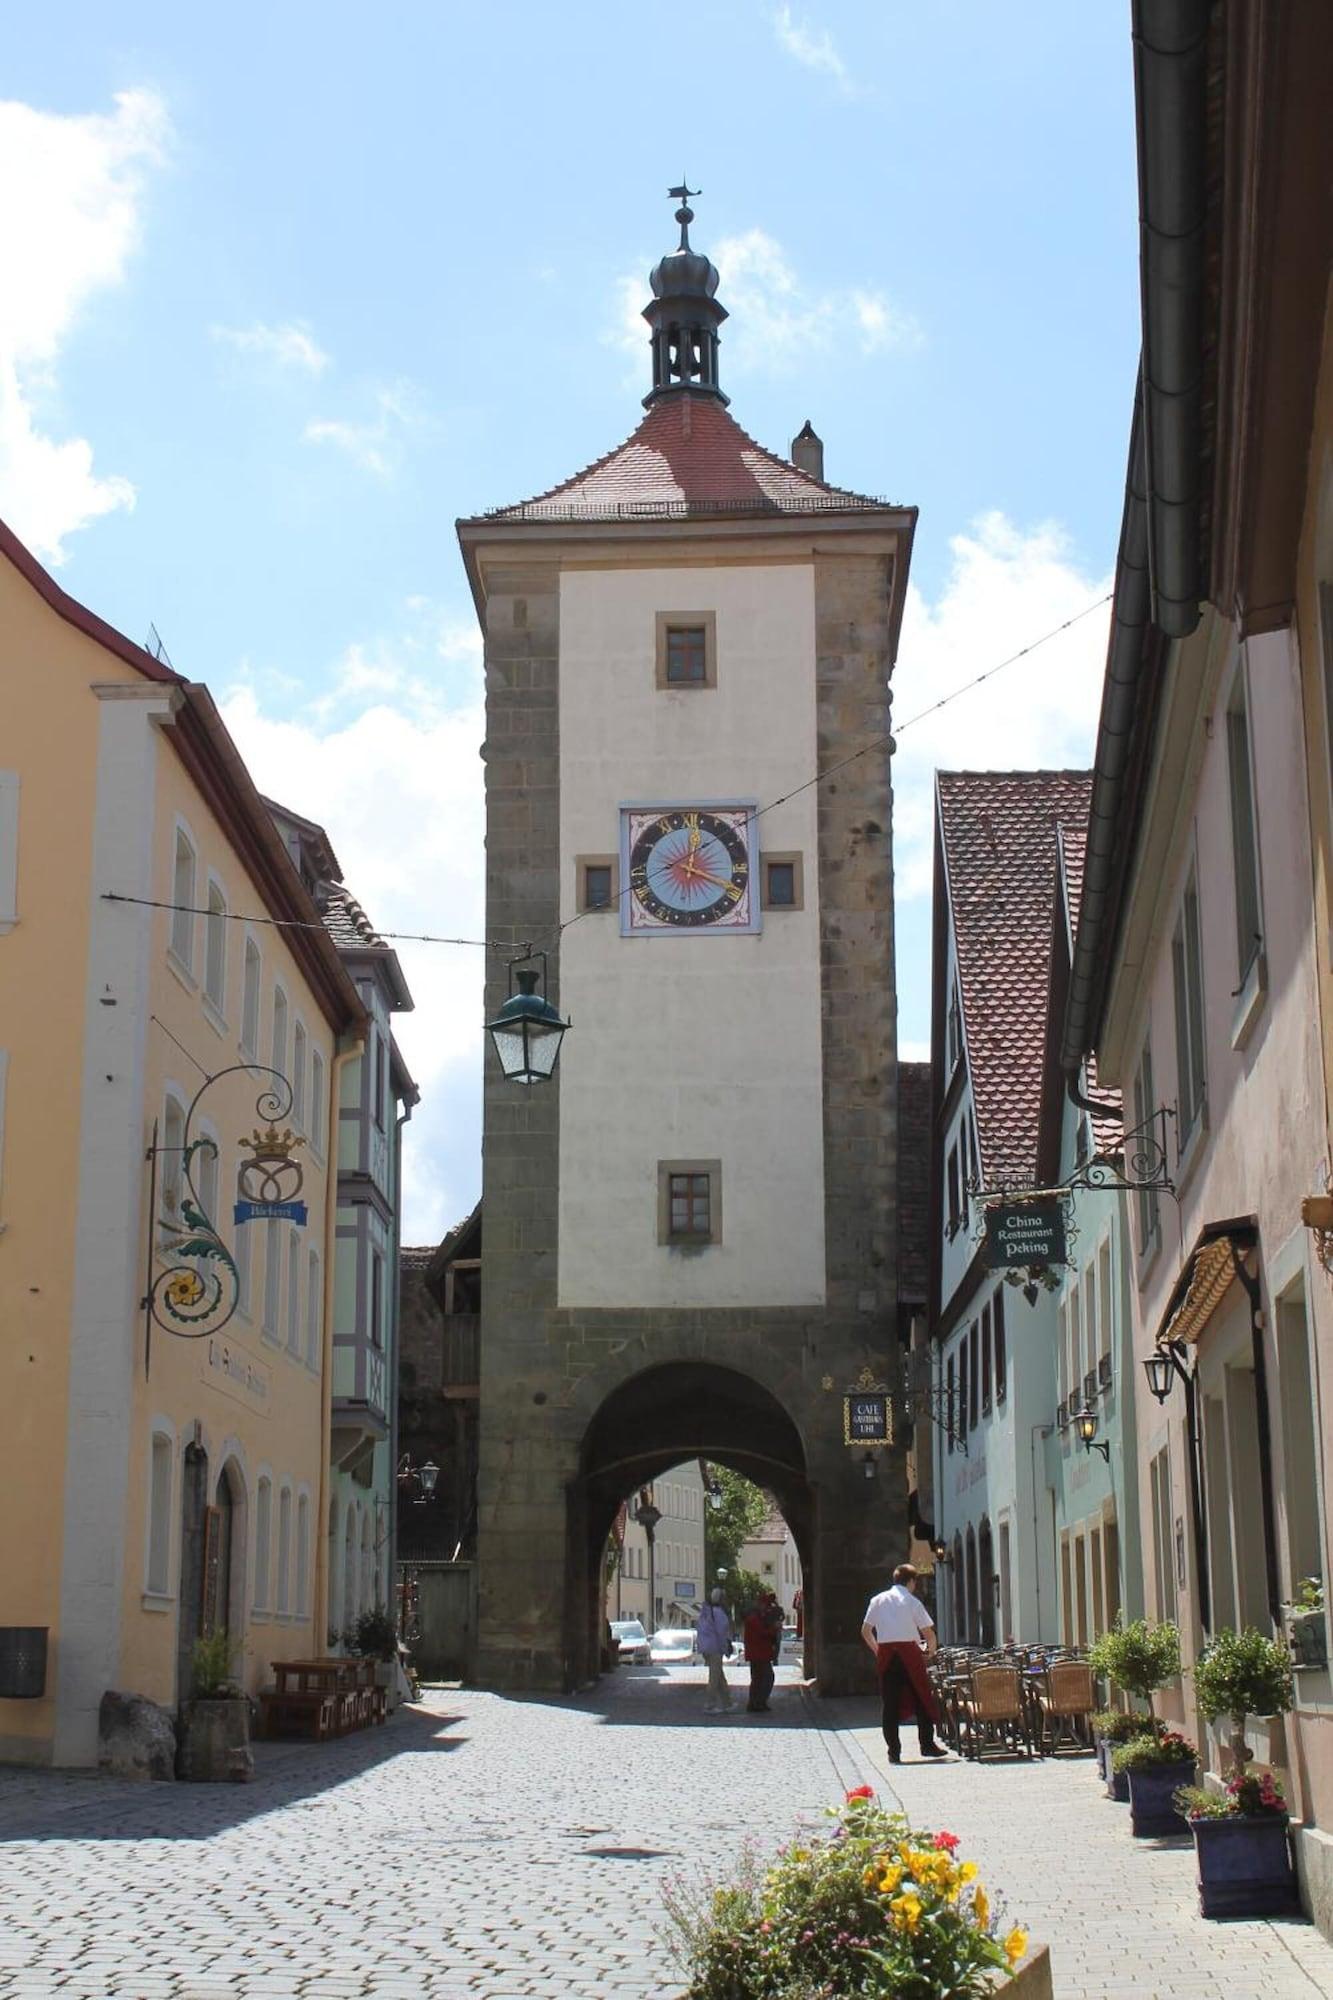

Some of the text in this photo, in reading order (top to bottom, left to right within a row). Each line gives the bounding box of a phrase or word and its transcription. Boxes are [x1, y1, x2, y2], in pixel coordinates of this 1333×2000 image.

[1006, 1216, 1043, 1228] China
[998, 1228, 1053, 1240] Restaurant
[1006, 1242, 1049, 1257] Peking
